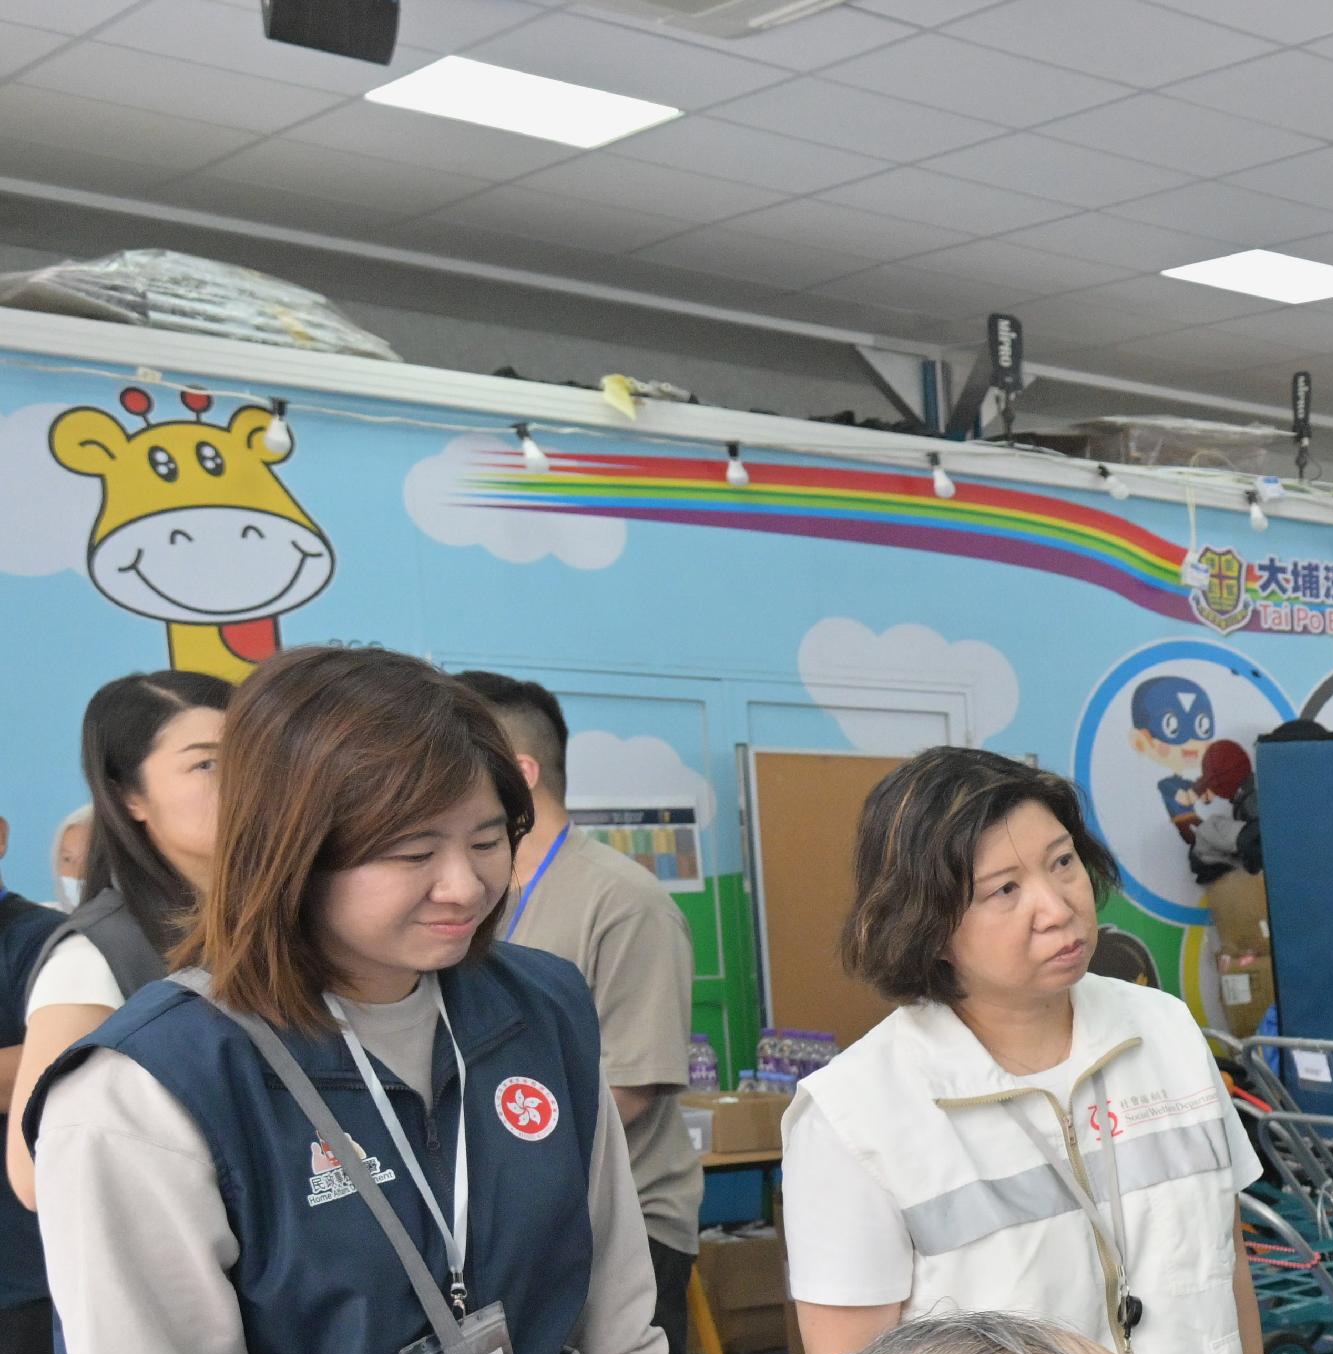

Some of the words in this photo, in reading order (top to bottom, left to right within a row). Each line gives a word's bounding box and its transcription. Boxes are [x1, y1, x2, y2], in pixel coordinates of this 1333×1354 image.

[1259, 605, 1289, 627] Tai
[1295, 608, 1324, 632] Po
[309, 1192, 334, 1204] Home
